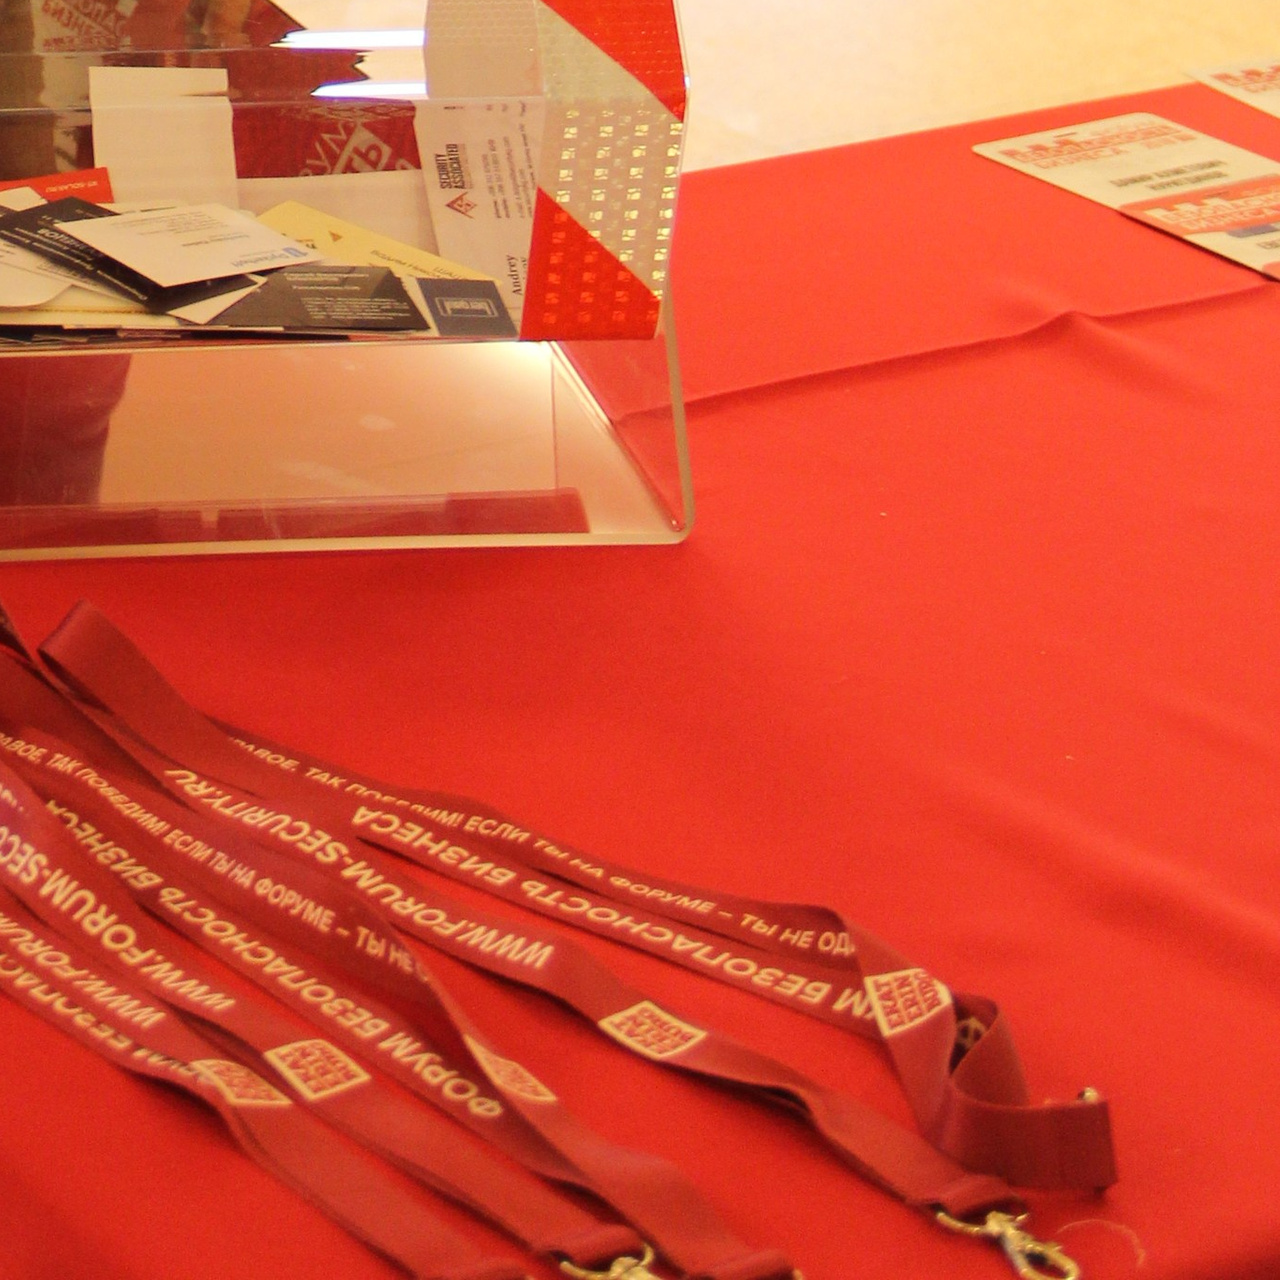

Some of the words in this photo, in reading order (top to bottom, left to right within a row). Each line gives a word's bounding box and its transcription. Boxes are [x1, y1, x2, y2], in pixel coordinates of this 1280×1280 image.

[434, 153, 452, 190] SECURITY
[446, 143, 465, 190] ASSOCIATED
[507, 254, 522, 296] Andrey
[46, 752, 82, 777] ТАК
[163, 828, 214, 861] ЕСЛИ
[208, 851, 232, 876] ТЫ
[229, 860, 257, 888] НА
[254, 878, 337, 934] ФОРУМЕ
[356, 926, 386, 956] ТЫ
[164, 768, 555, 970] WWW.FORUM-SECURITY.RU
[305, 766, 347, 789] ТАК
[463, 815, 531, 843] ЕСЛИ
[533, 839, 569, 859] ТЫ
[569, 857, 605, 879] НА
[609, 876, 717, 914] ФОРУМЕ
[740, 912, 778, 937] ТЫ
[780, 927, 815, 949] НЕ
[817, 930, 857, 958] ОД
[351, 805, 517, 886] БИЗНЕСА
[159, 886, 391, 1038] БЕЗОПАСНОСТЬ
[521, 879, 832, 1005] БЕЗОПАСНОСТЬ
[378, 1031, 504, 1118] ФОРУМ
